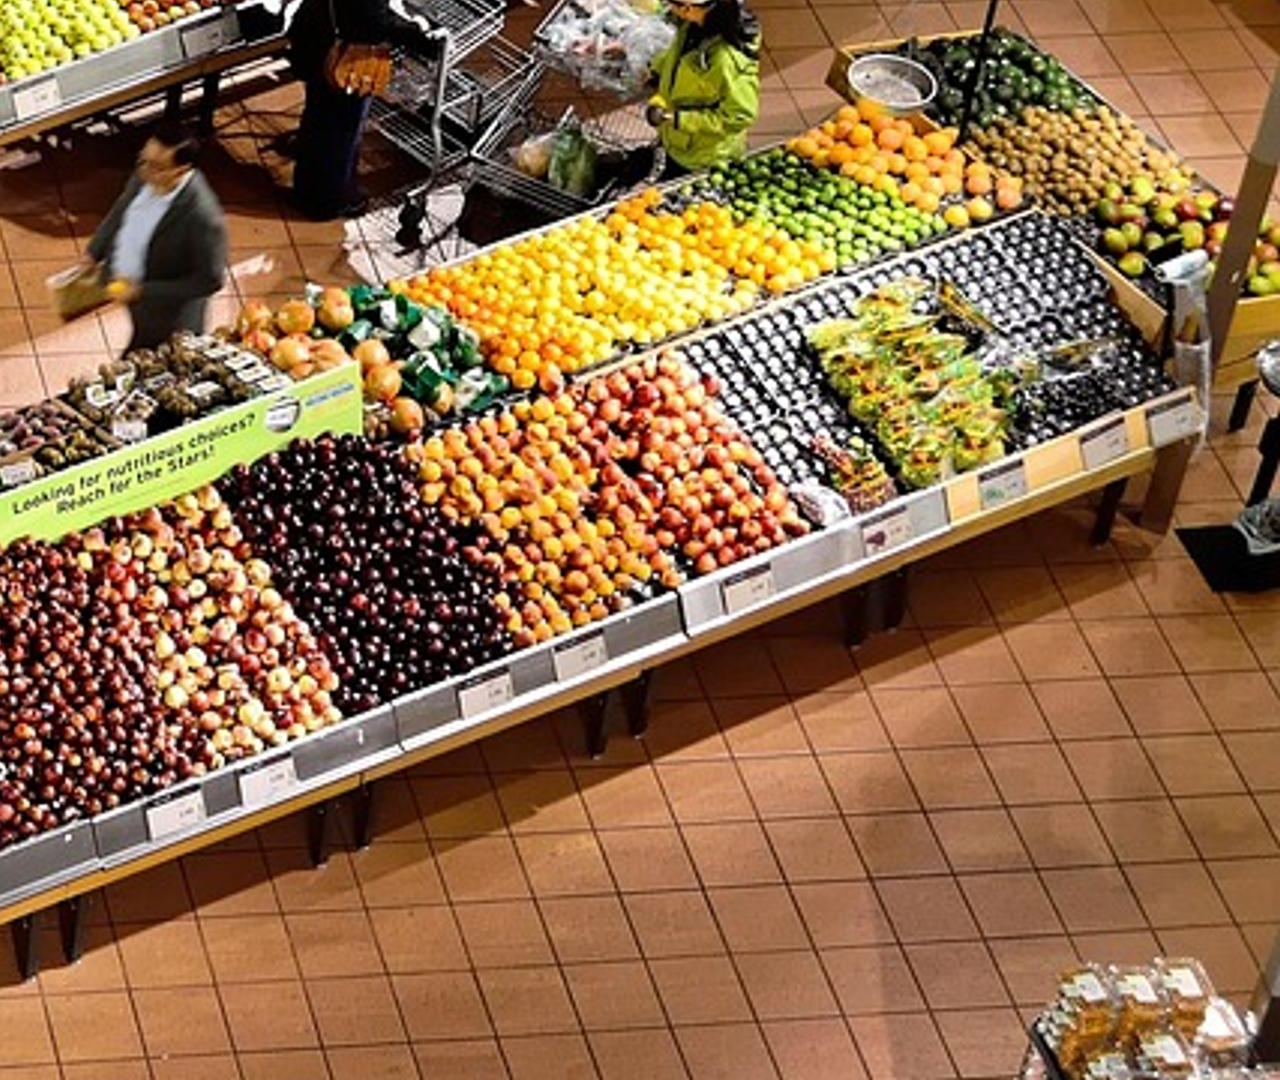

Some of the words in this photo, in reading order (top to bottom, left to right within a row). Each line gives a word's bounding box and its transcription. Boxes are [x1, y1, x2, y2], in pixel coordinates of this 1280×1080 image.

[12, 482, 76, 514] Looking
[79, 473, 101, 489] for
[106, 442, 184, 480] nutritious
[188, 412, 256, 448] choices?
[56, 488, 105, 514] Reach
[109, 477, 133, 494] for
[136, 466, 163, 484] the
[167, 444, 216, 473] Stars!
